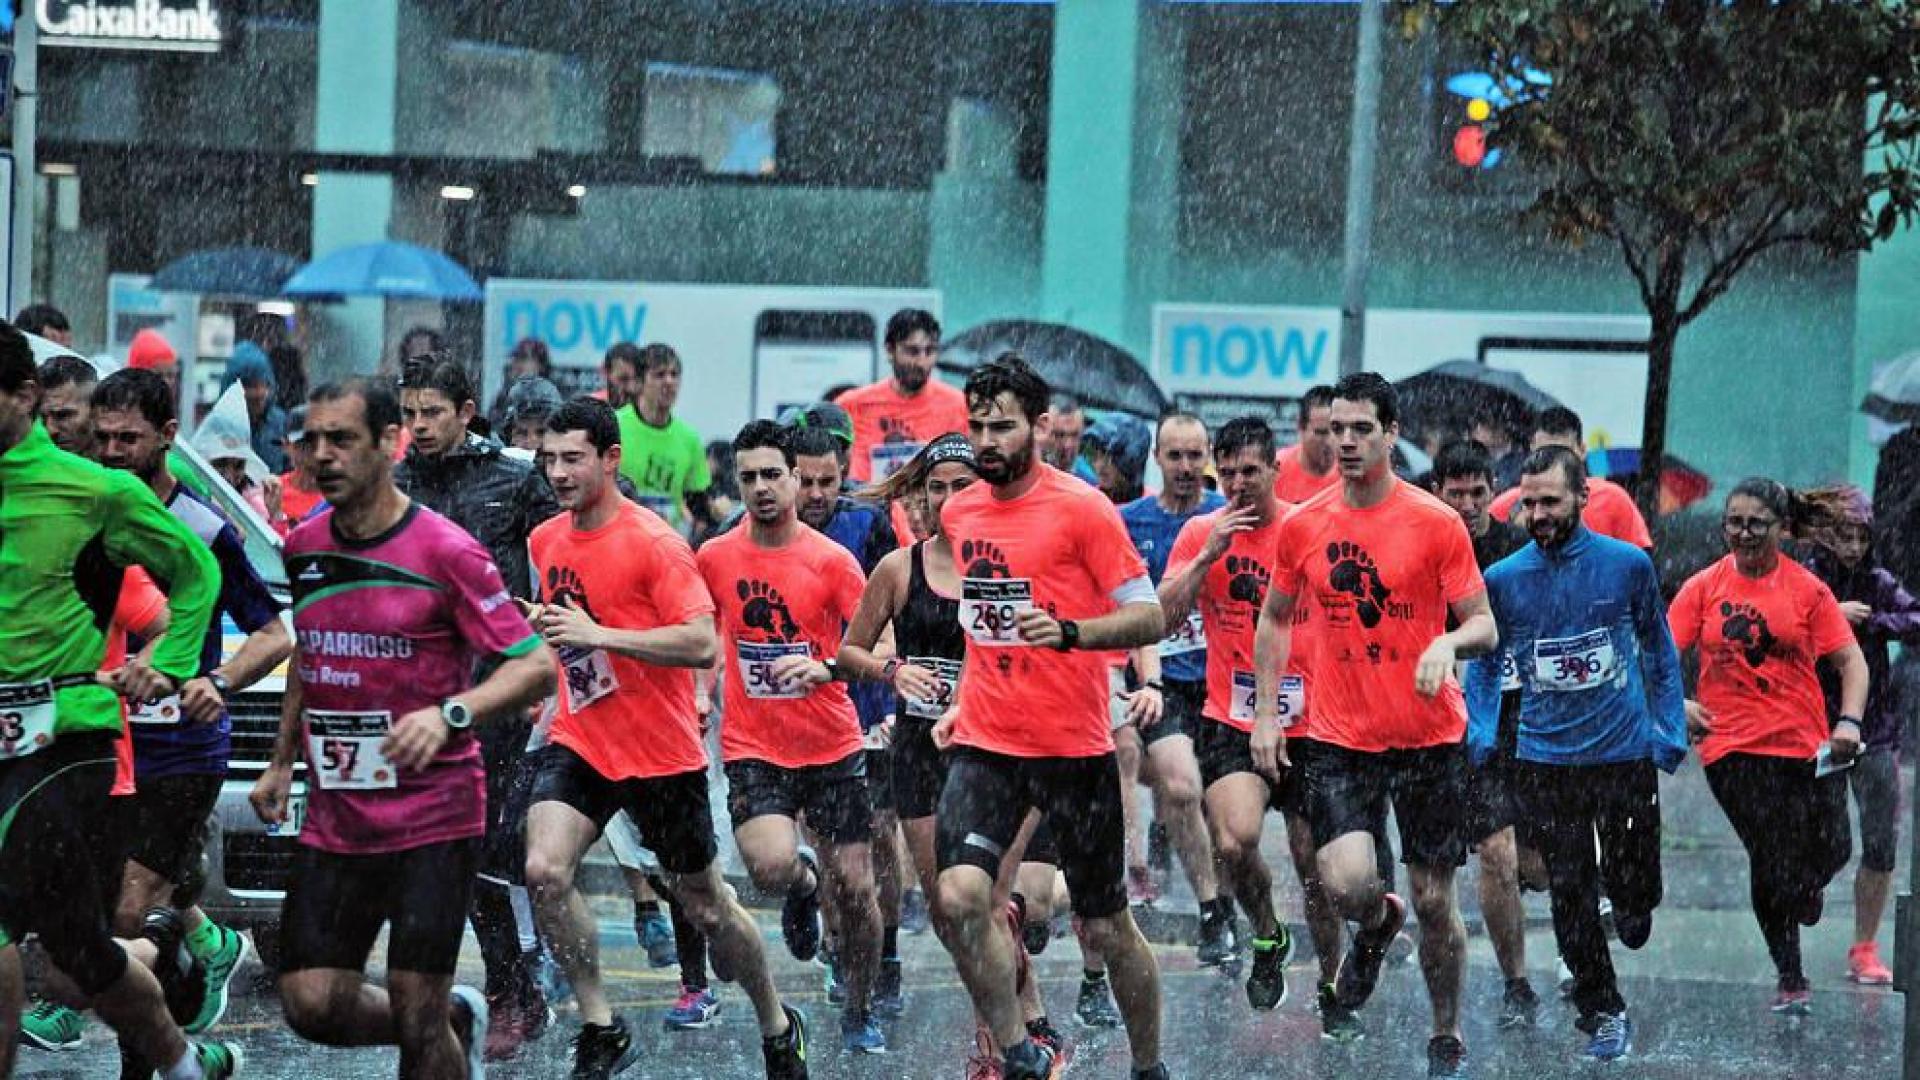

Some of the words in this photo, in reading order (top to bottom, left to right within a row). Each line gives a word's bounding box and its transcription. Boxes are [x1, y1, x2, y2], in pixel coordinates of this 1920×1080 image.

[35, 0, 221, 40] CaixaBank
[504, 299, 648, 350] now
[1171, 323, 1329, 380] now
[971, 604, 1016, 631] 269
[323, 740, 360, 771] 57
